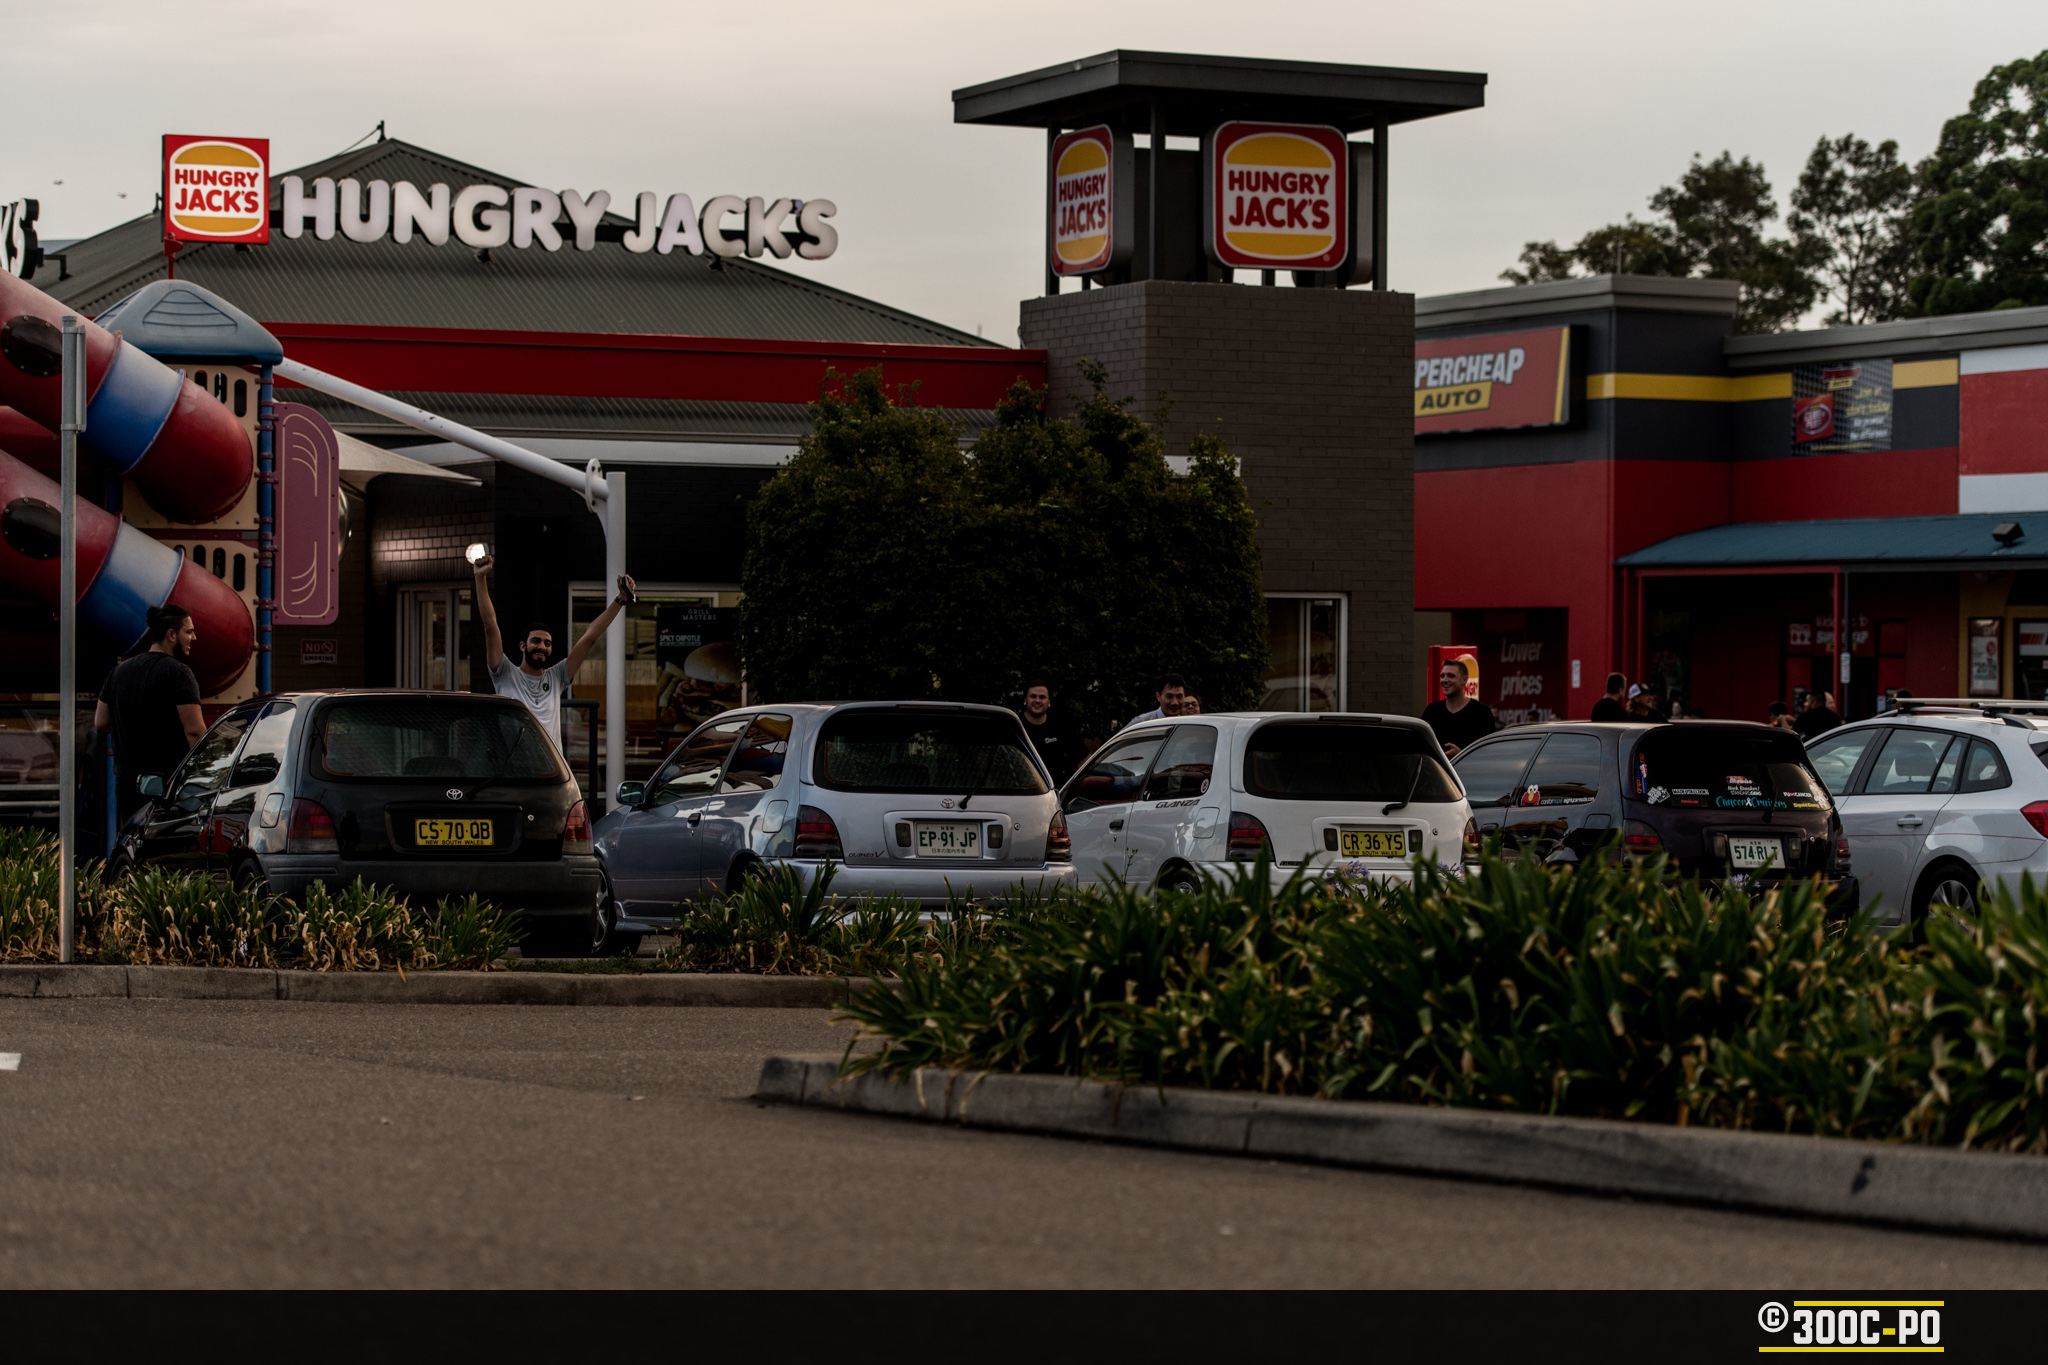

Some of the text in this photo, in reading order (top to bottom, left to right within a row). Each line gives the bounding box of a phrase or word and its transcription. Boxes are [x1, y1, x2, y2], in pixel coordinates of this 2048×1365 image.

[175, 169, 258, 188] HUNGRY
[1059, 173, 1106, 203] HUNGRY
[1228, 170, 1330, 194] HUNGRY
[175, 188, 259, 213] JACK'S
[1228, 196, 1330, 229] JACK'S
[280, 175, 839, 260] HUNGRY JACK'S
[1059, 199, 1106, 236] JACK'S
[1415, 347, 1526, 389] PERCHEAP
[1421, 389, 1482, 410] AUTO
[305, 642, 321, 653] NO
[1500, 638, 1543, 663] Lower
[1500, 670, 1543, 702] prices
[1155, 799, 1200, 808] GLANZA
[1716, 795, 1747, 808] Cancer
